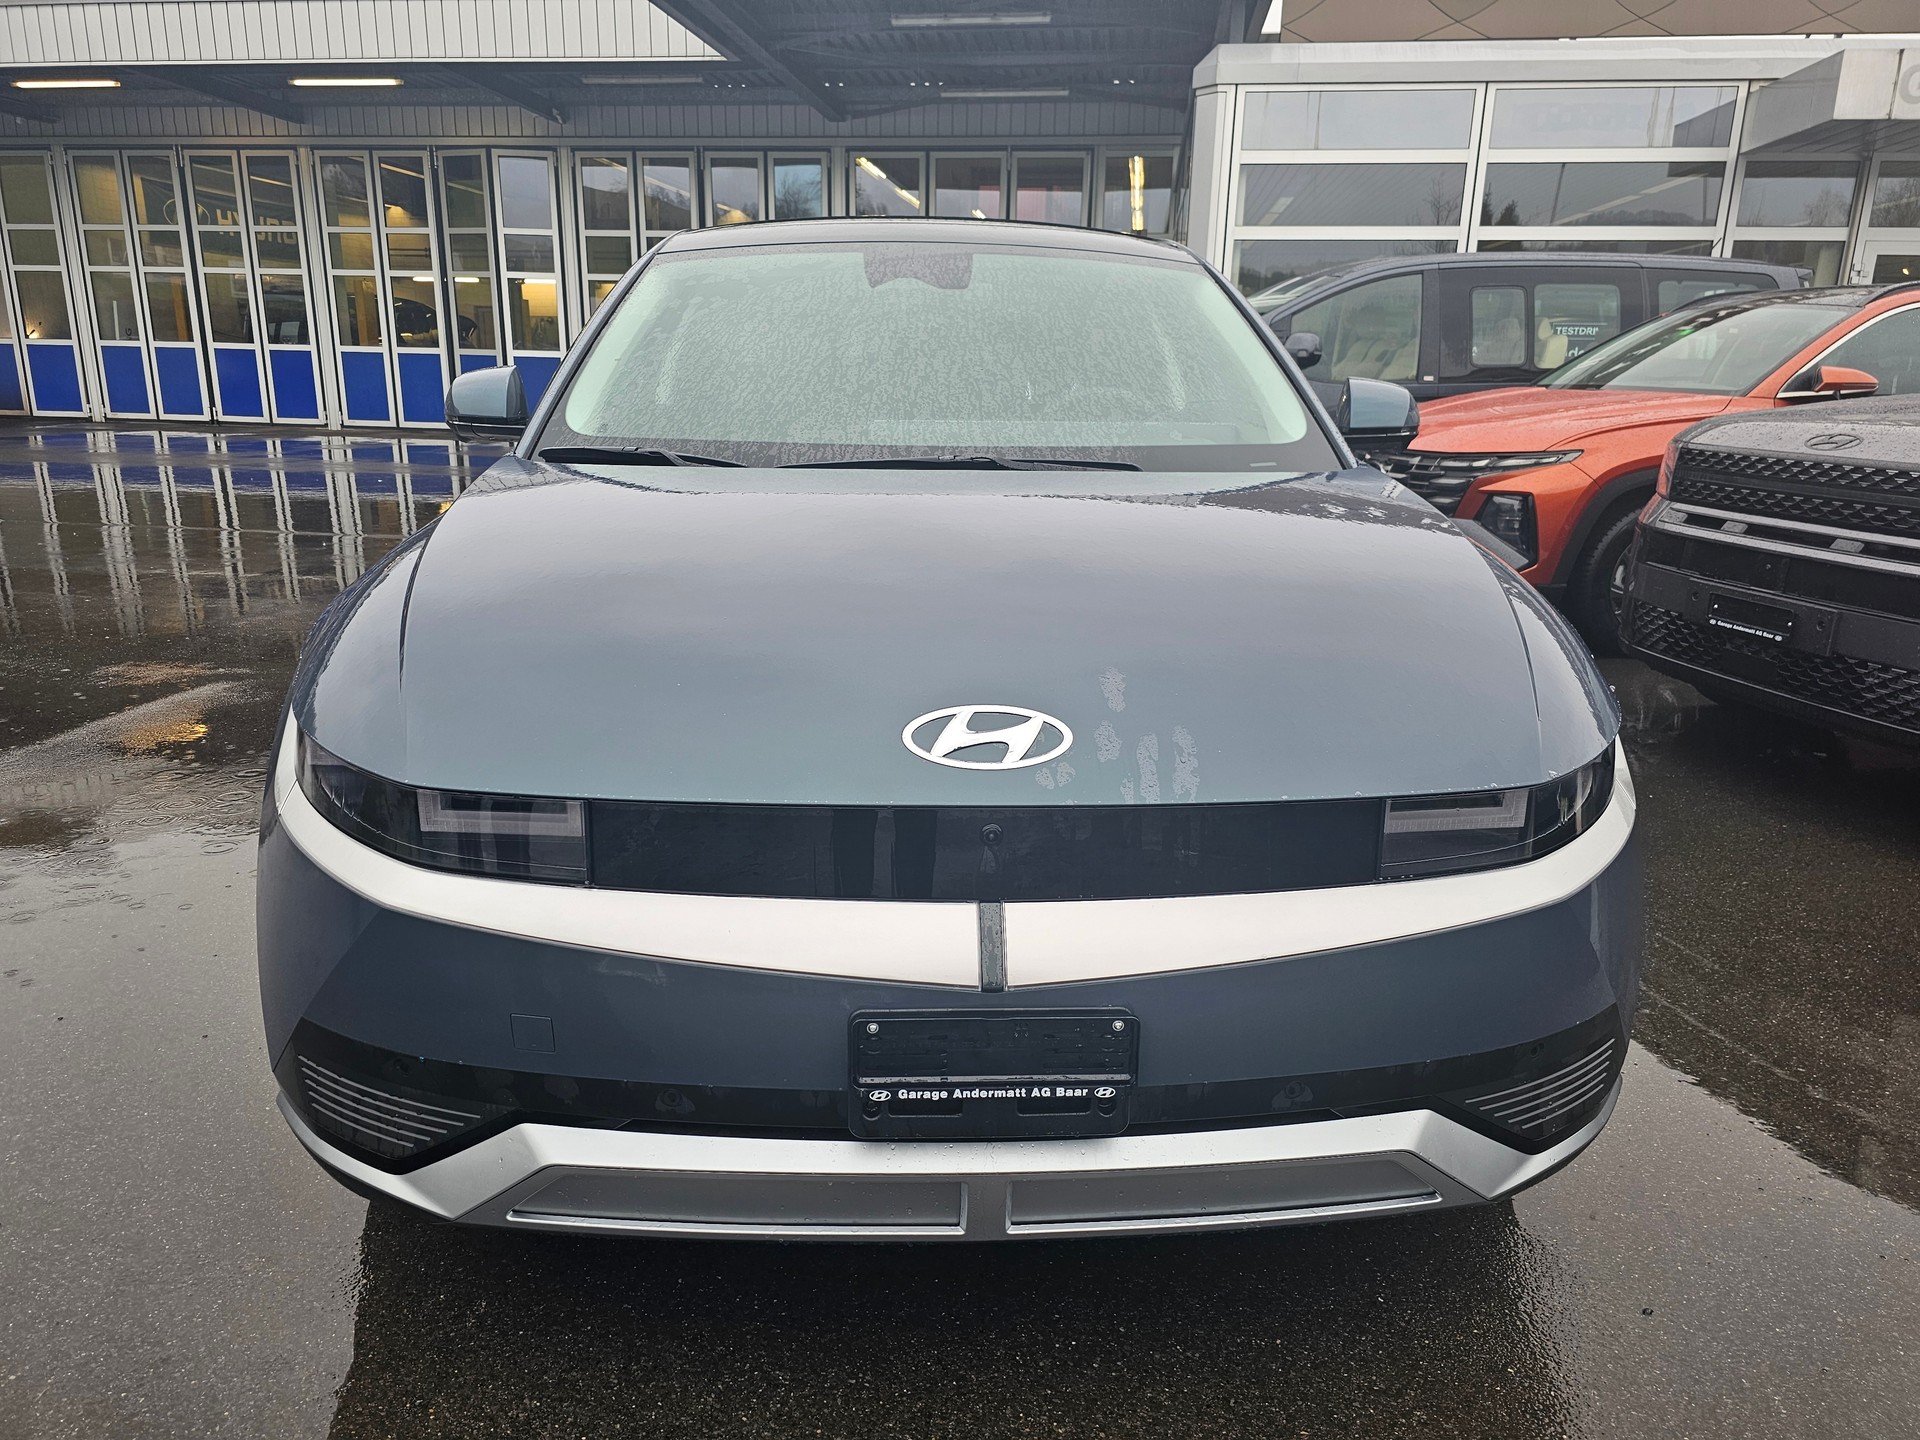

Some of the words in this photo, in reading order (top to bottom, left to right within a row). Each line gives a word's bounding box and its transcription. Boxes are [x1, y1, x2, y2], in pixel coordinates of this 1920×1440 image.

[898, 1089, 948, 1100] Garage
[952, 1088, 1027, 1098] Andermatt
[1031, 1088, 1051, 1098] AG
[1055, 1087, 1088, 1097] Baar
